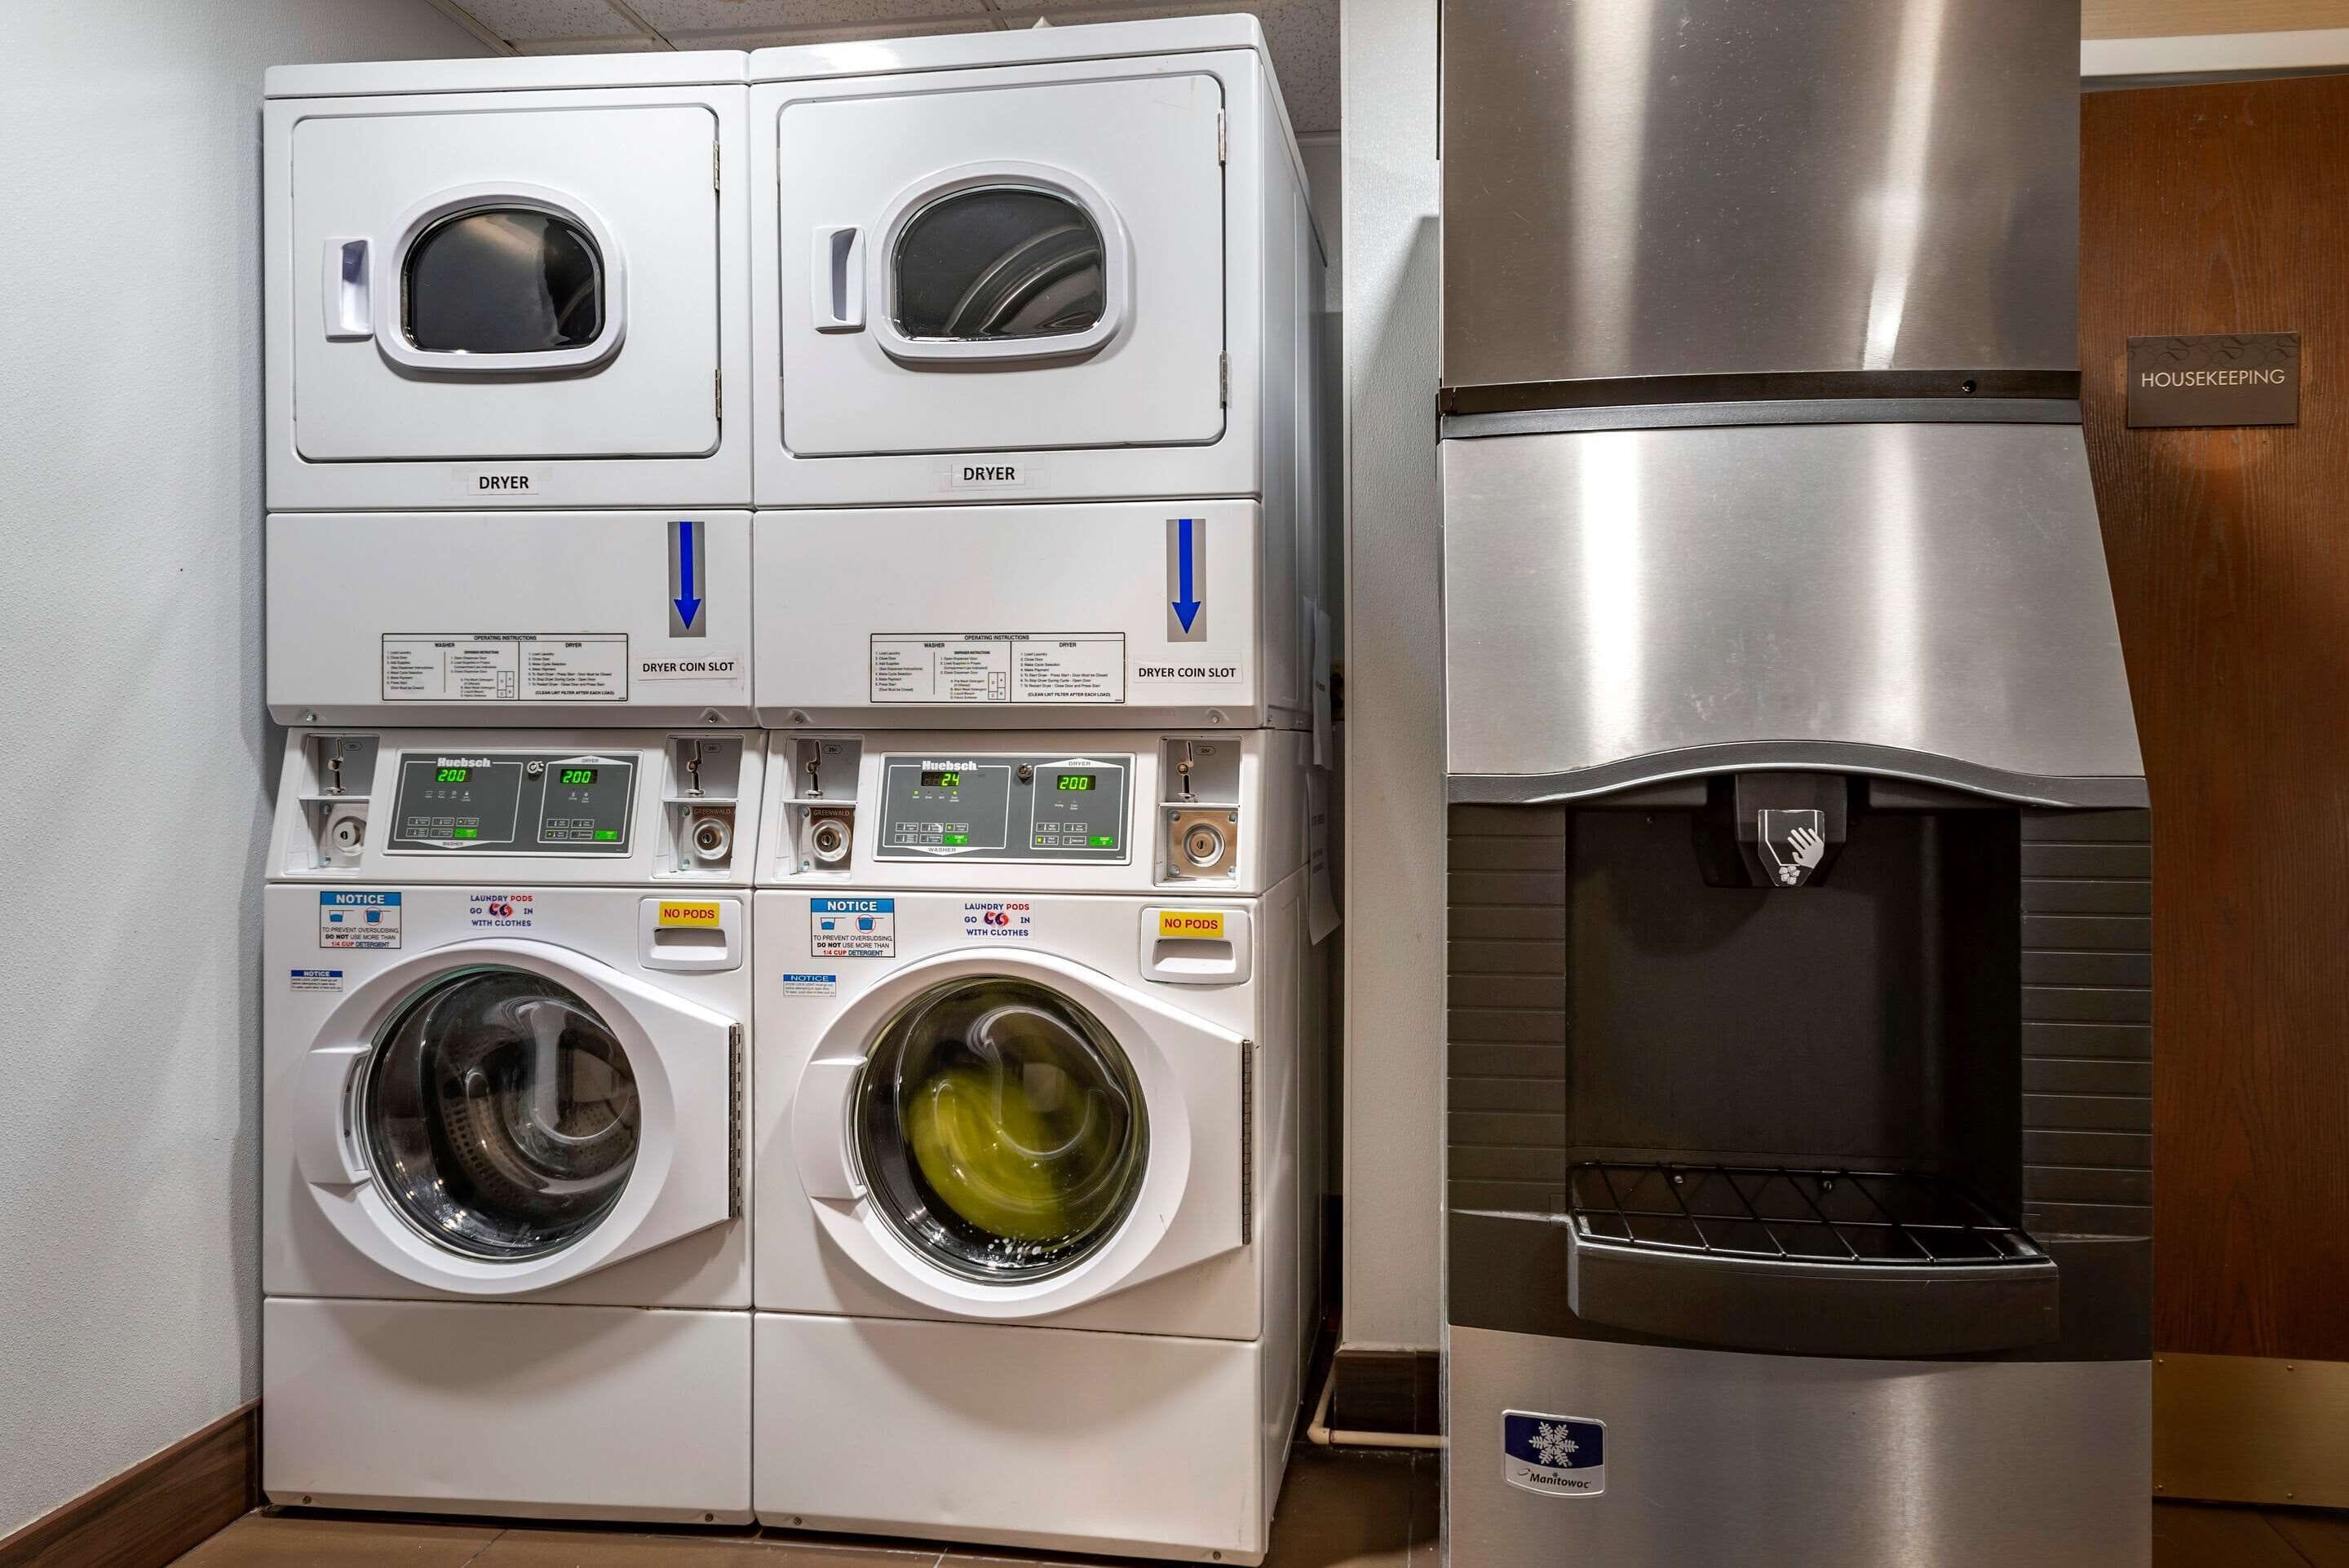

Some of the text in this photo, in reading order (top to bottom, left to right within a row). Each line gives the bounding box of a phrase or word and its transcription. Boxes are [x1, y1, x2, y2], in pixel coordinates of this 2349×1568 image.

[2142, 369, 2285, 386] HOUSEKEEPING
[964, 467, 1015, 480] DRYER
[480, 476, 529, 488] DRYER
[643, 662, 734, 672] DRYER COIN SLOT
[1139, 668, 1236, 677] DRYER COIN SLOT
[437, 757, 491, 767] Huebsch
[922, 761, 977, 771] Huebsch
[437, 770, 467, 781] 200
[563, 771, 591, 783] 200
[941, 773, 959, 786] 24
[1059, 777, 1088, 789] 200
[336, 894, 384, 903] NOTICE
[827, 901, 877, 911] NOTICE
[664, 909, 714, 918] NO PODS
[1165, 919, 1218, 929] NO PODS
[1529, 1472, 1590, 1489] Manitowoc
